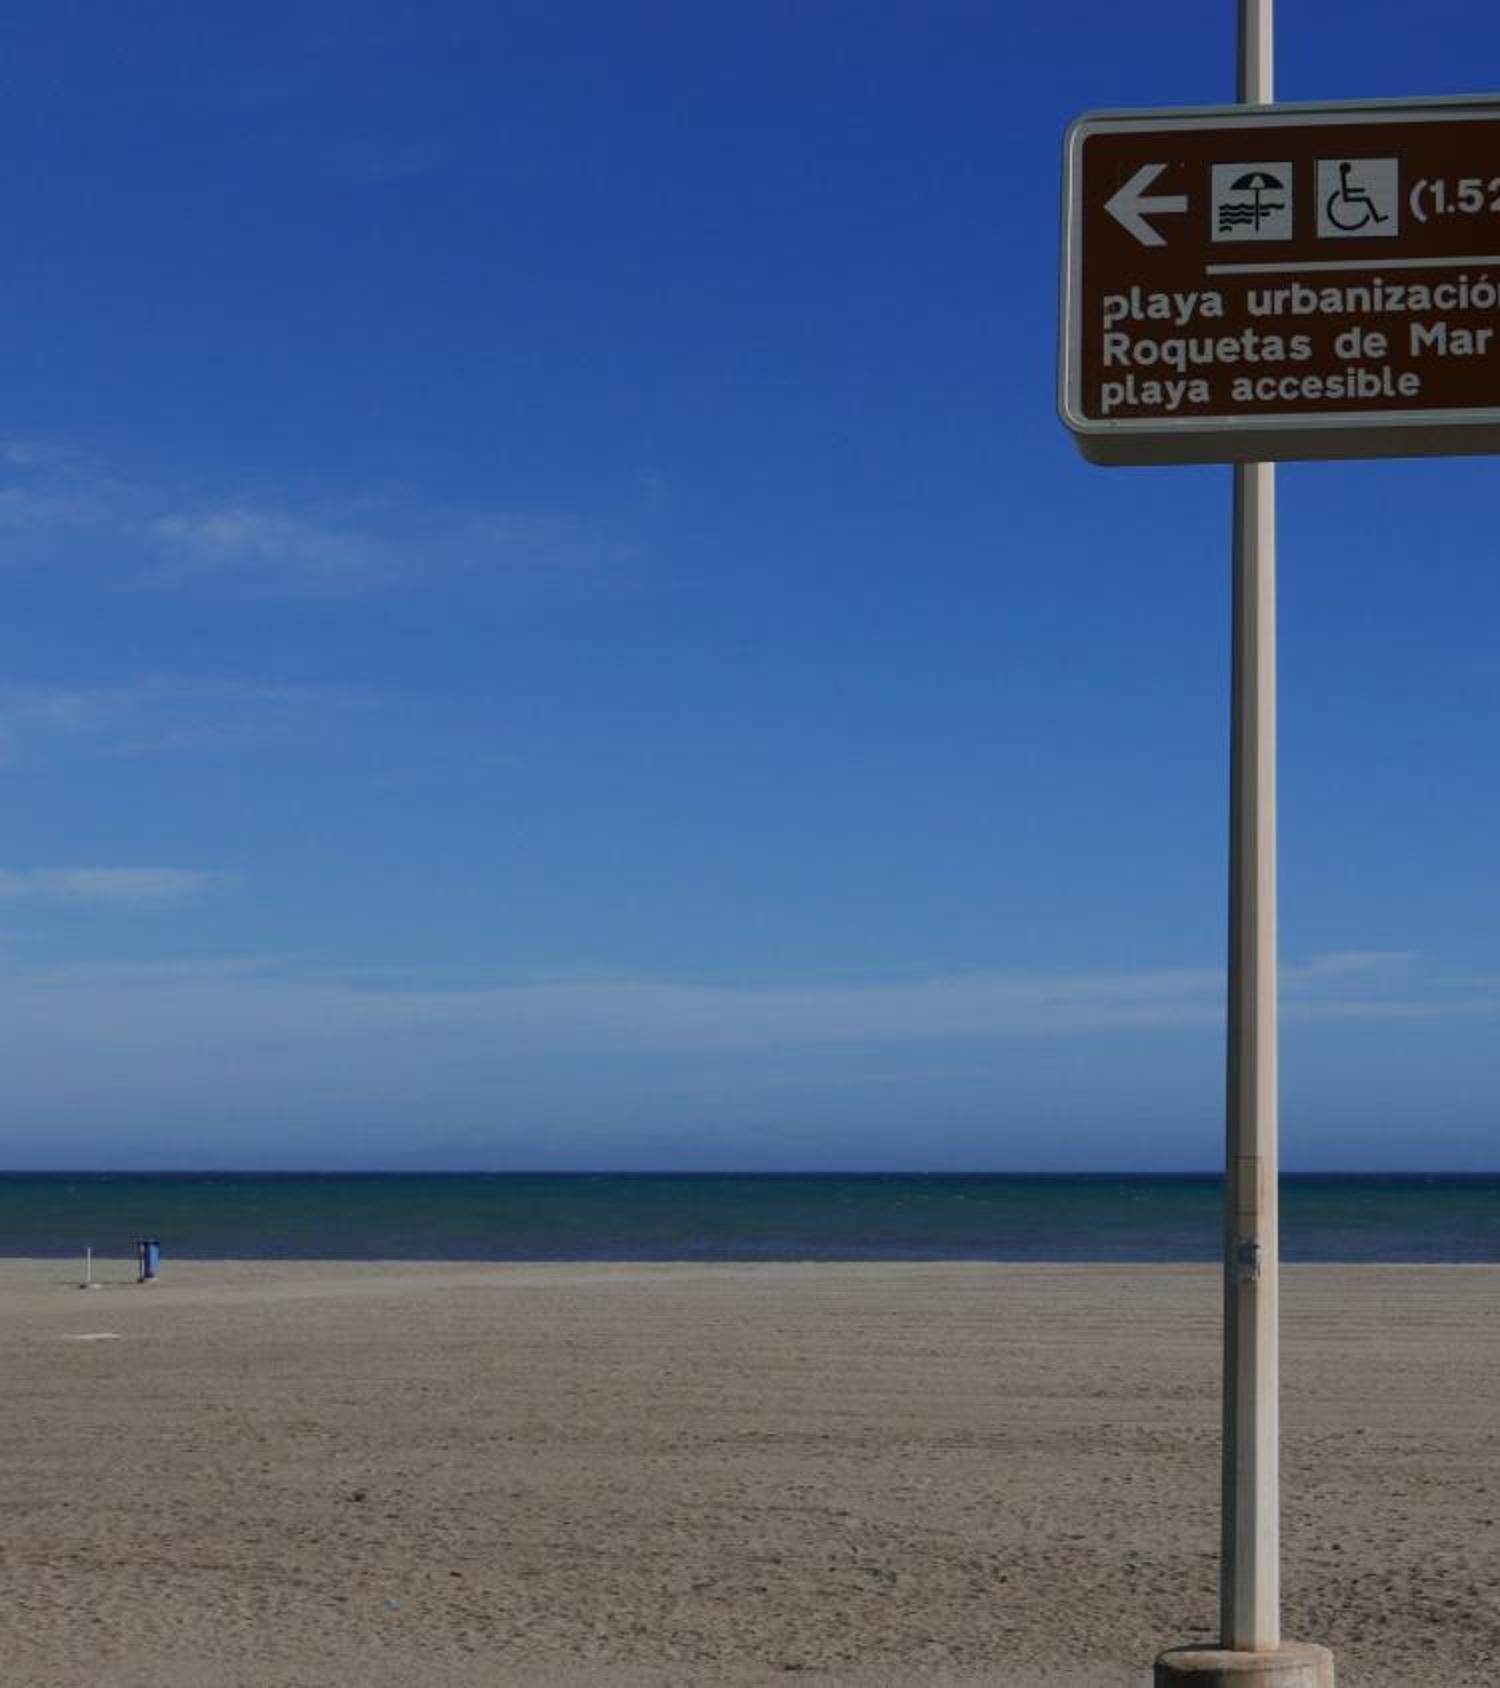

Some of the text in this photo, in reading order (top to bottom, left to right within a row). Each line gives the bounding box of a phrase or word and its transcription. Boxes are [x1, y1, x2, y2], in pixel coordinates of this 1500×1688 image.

[1103, 285, 1224, 330] playa
[1103, 321, 1493, 373] Roquetas de Mar
[1101, 365, 1420, 414] playa accesible
